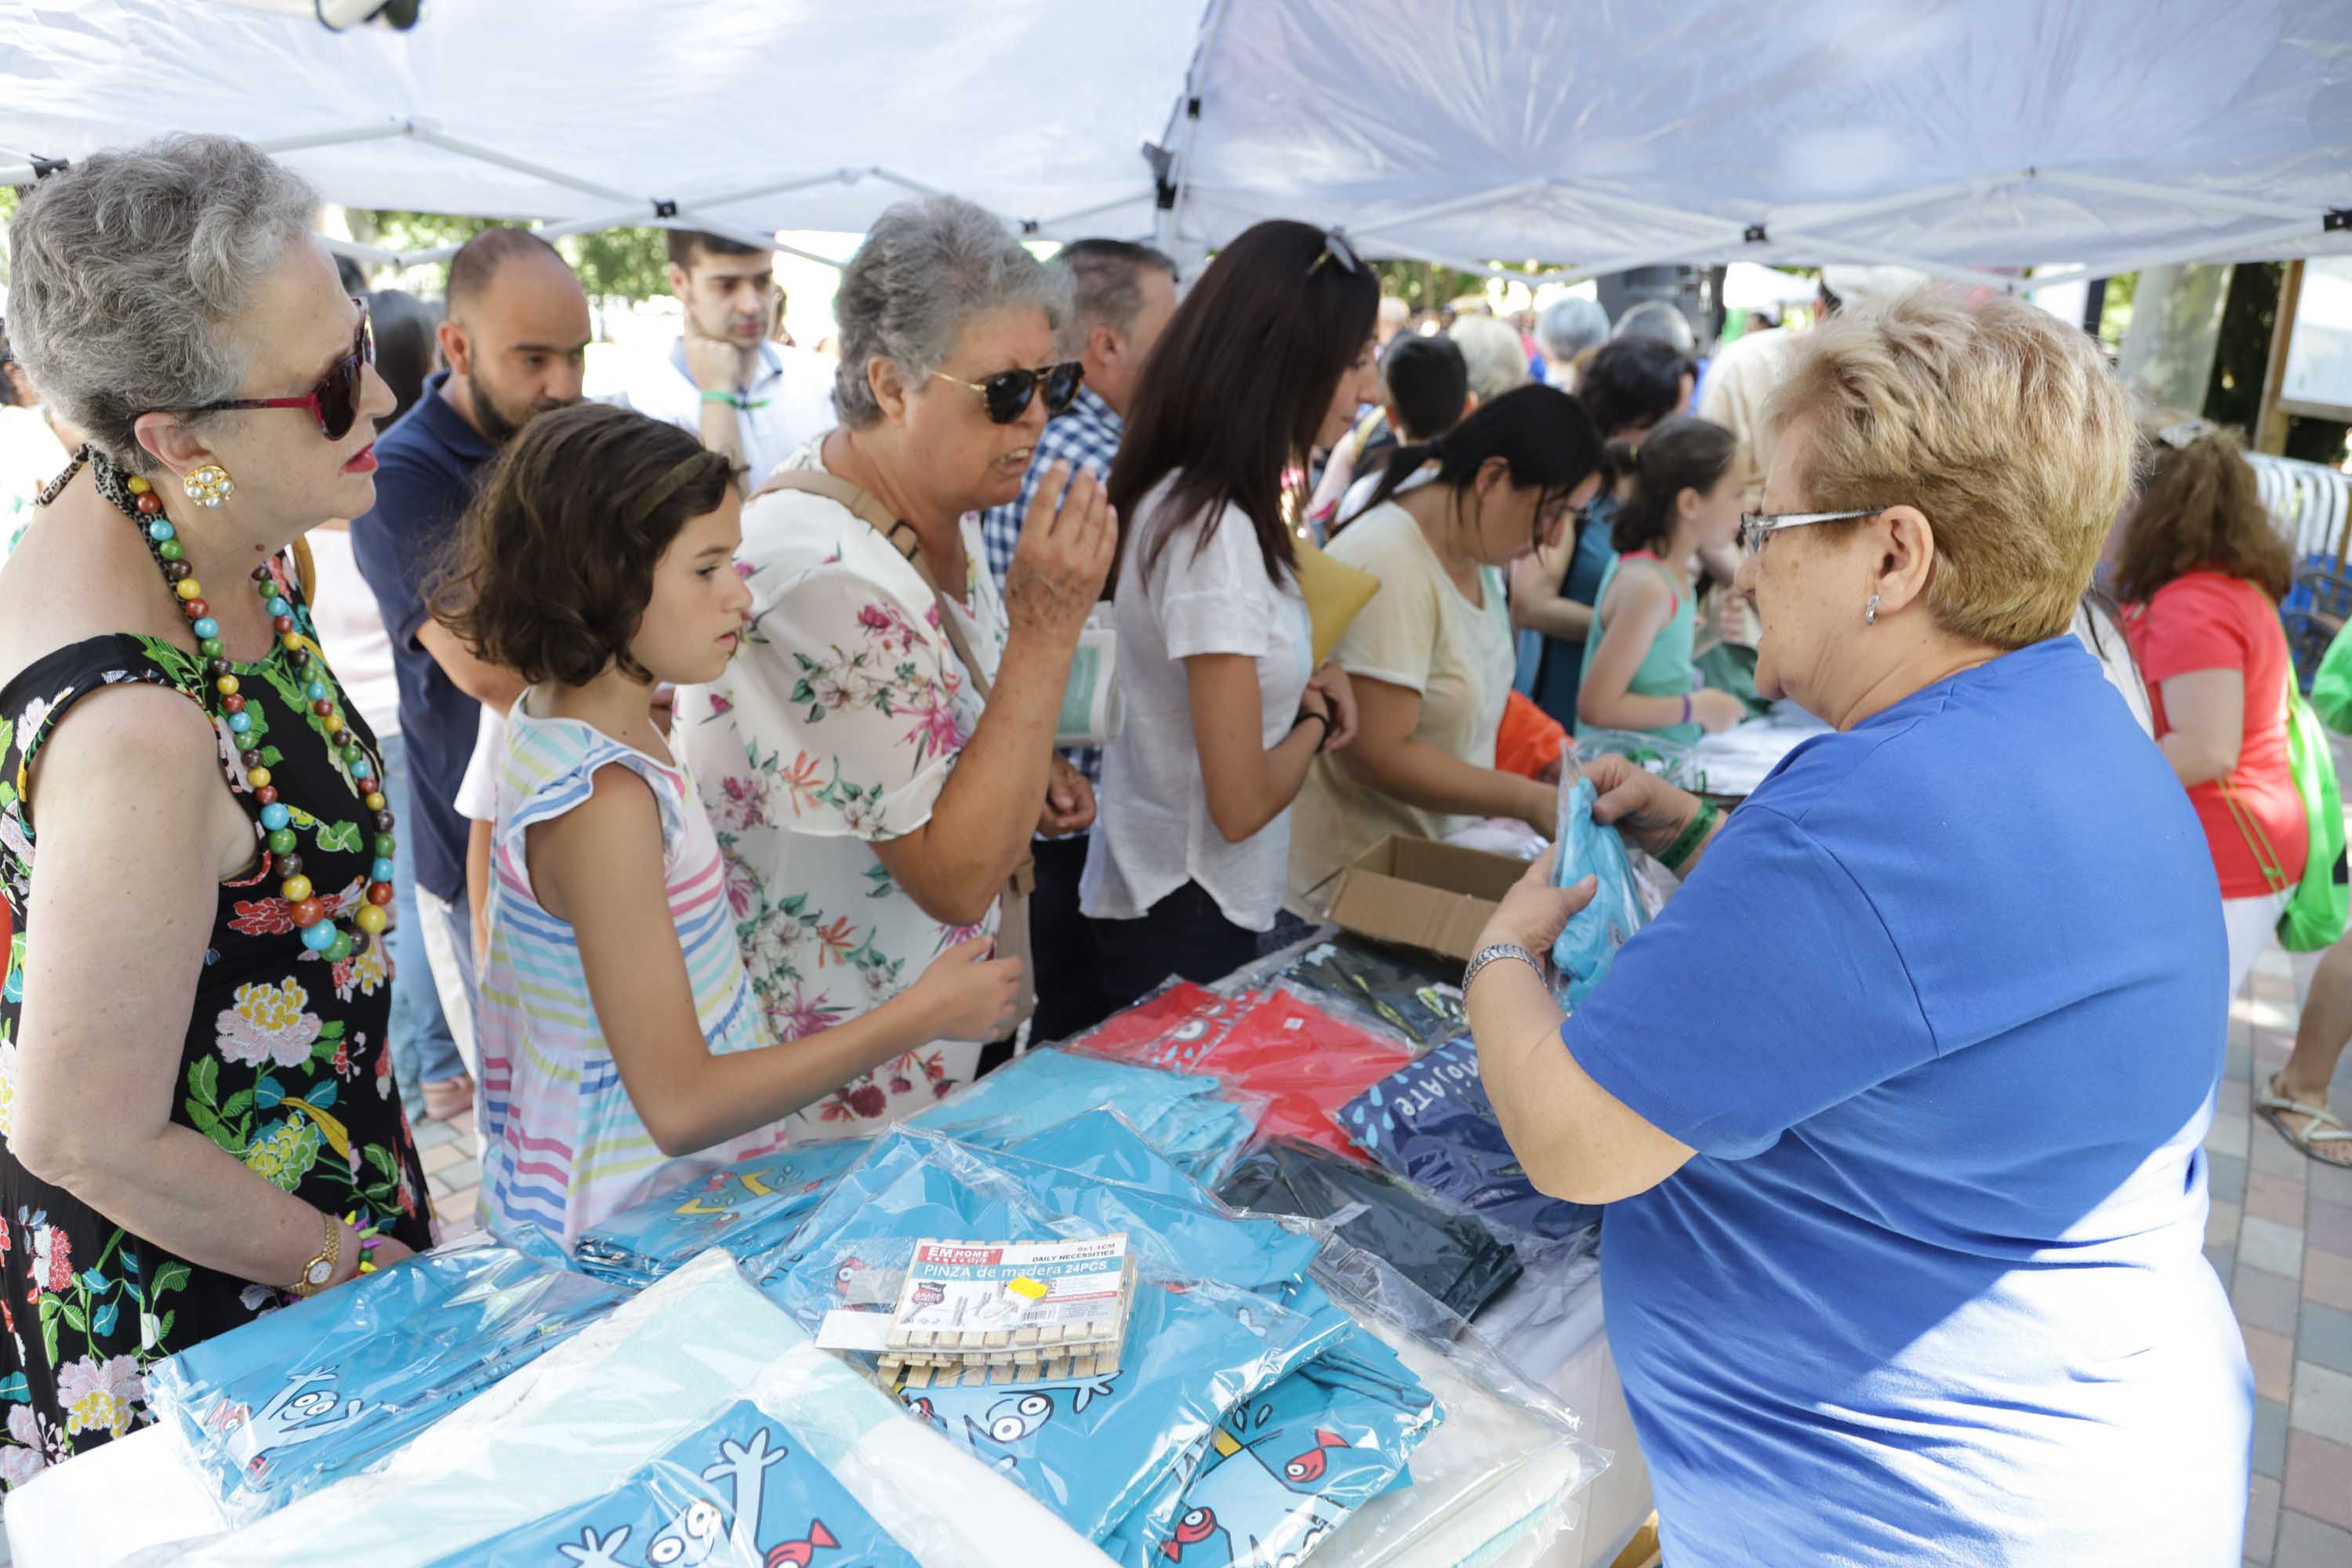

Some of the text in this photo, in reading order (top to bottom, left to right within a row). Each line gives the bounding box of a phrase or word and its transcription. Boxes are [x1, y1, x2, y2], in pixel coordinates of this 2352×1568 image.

[927, 1247, 989, 1258] EM HOME
[1058, 1250, 1115, 1261] NECESSITIES
[923, 1260, 1108, 1278] PINZA de madera 24PCS
